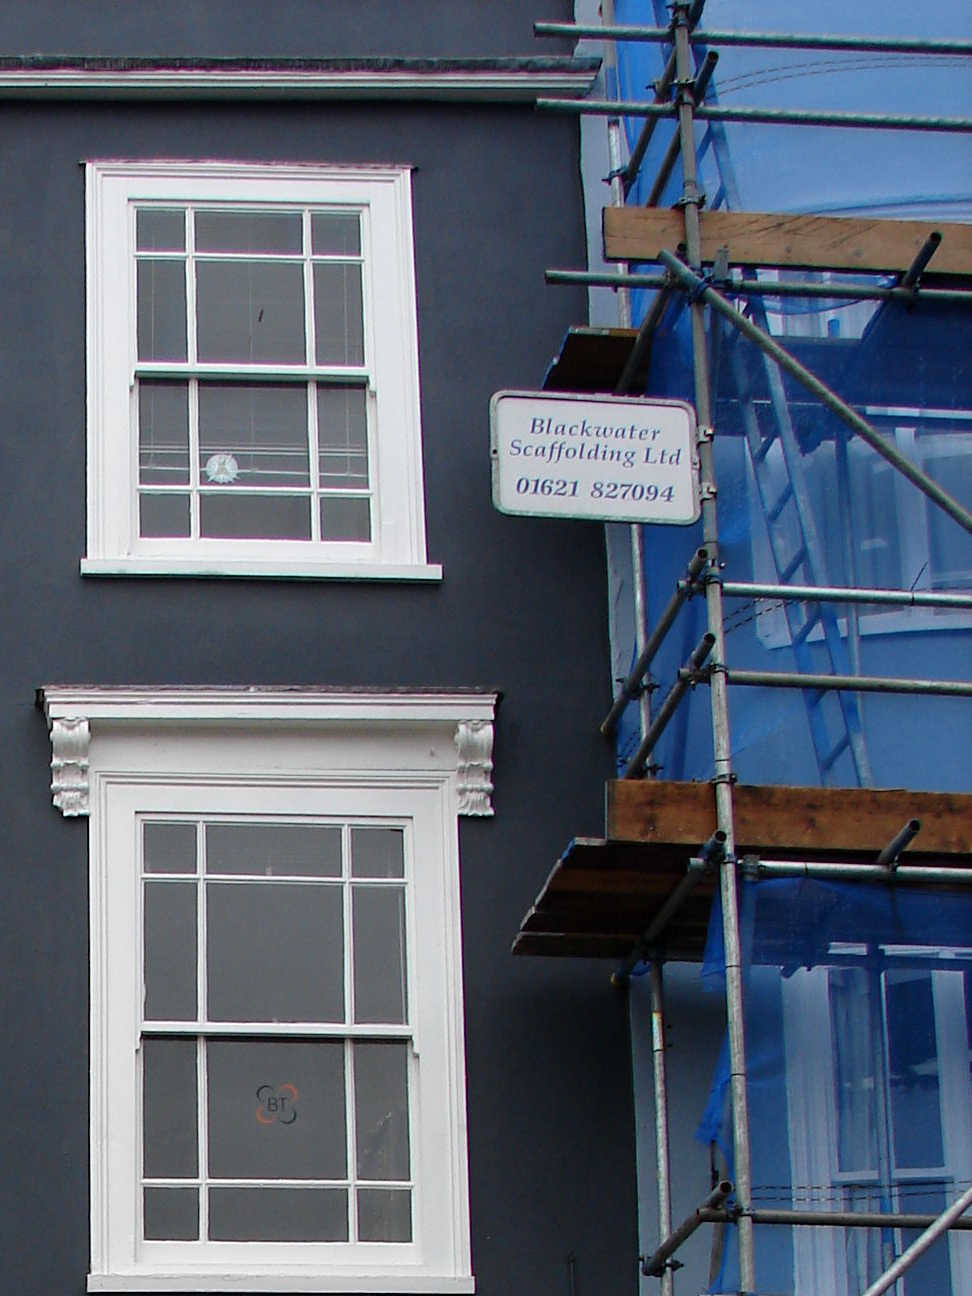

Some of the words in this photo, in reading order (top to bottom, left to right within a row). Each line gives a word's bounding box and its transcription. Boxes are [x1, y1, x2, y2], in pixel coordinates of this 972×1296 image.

[530, 417, 660, 441] Blackwater
[509, 440, 636, 468] Scaffolding
[643, 447, 682, 465] Ltd
[516, 477, 578, 497] 01621
[590, 482, 675, 503] 827094
[267, 1097, 287, 1112] BT
